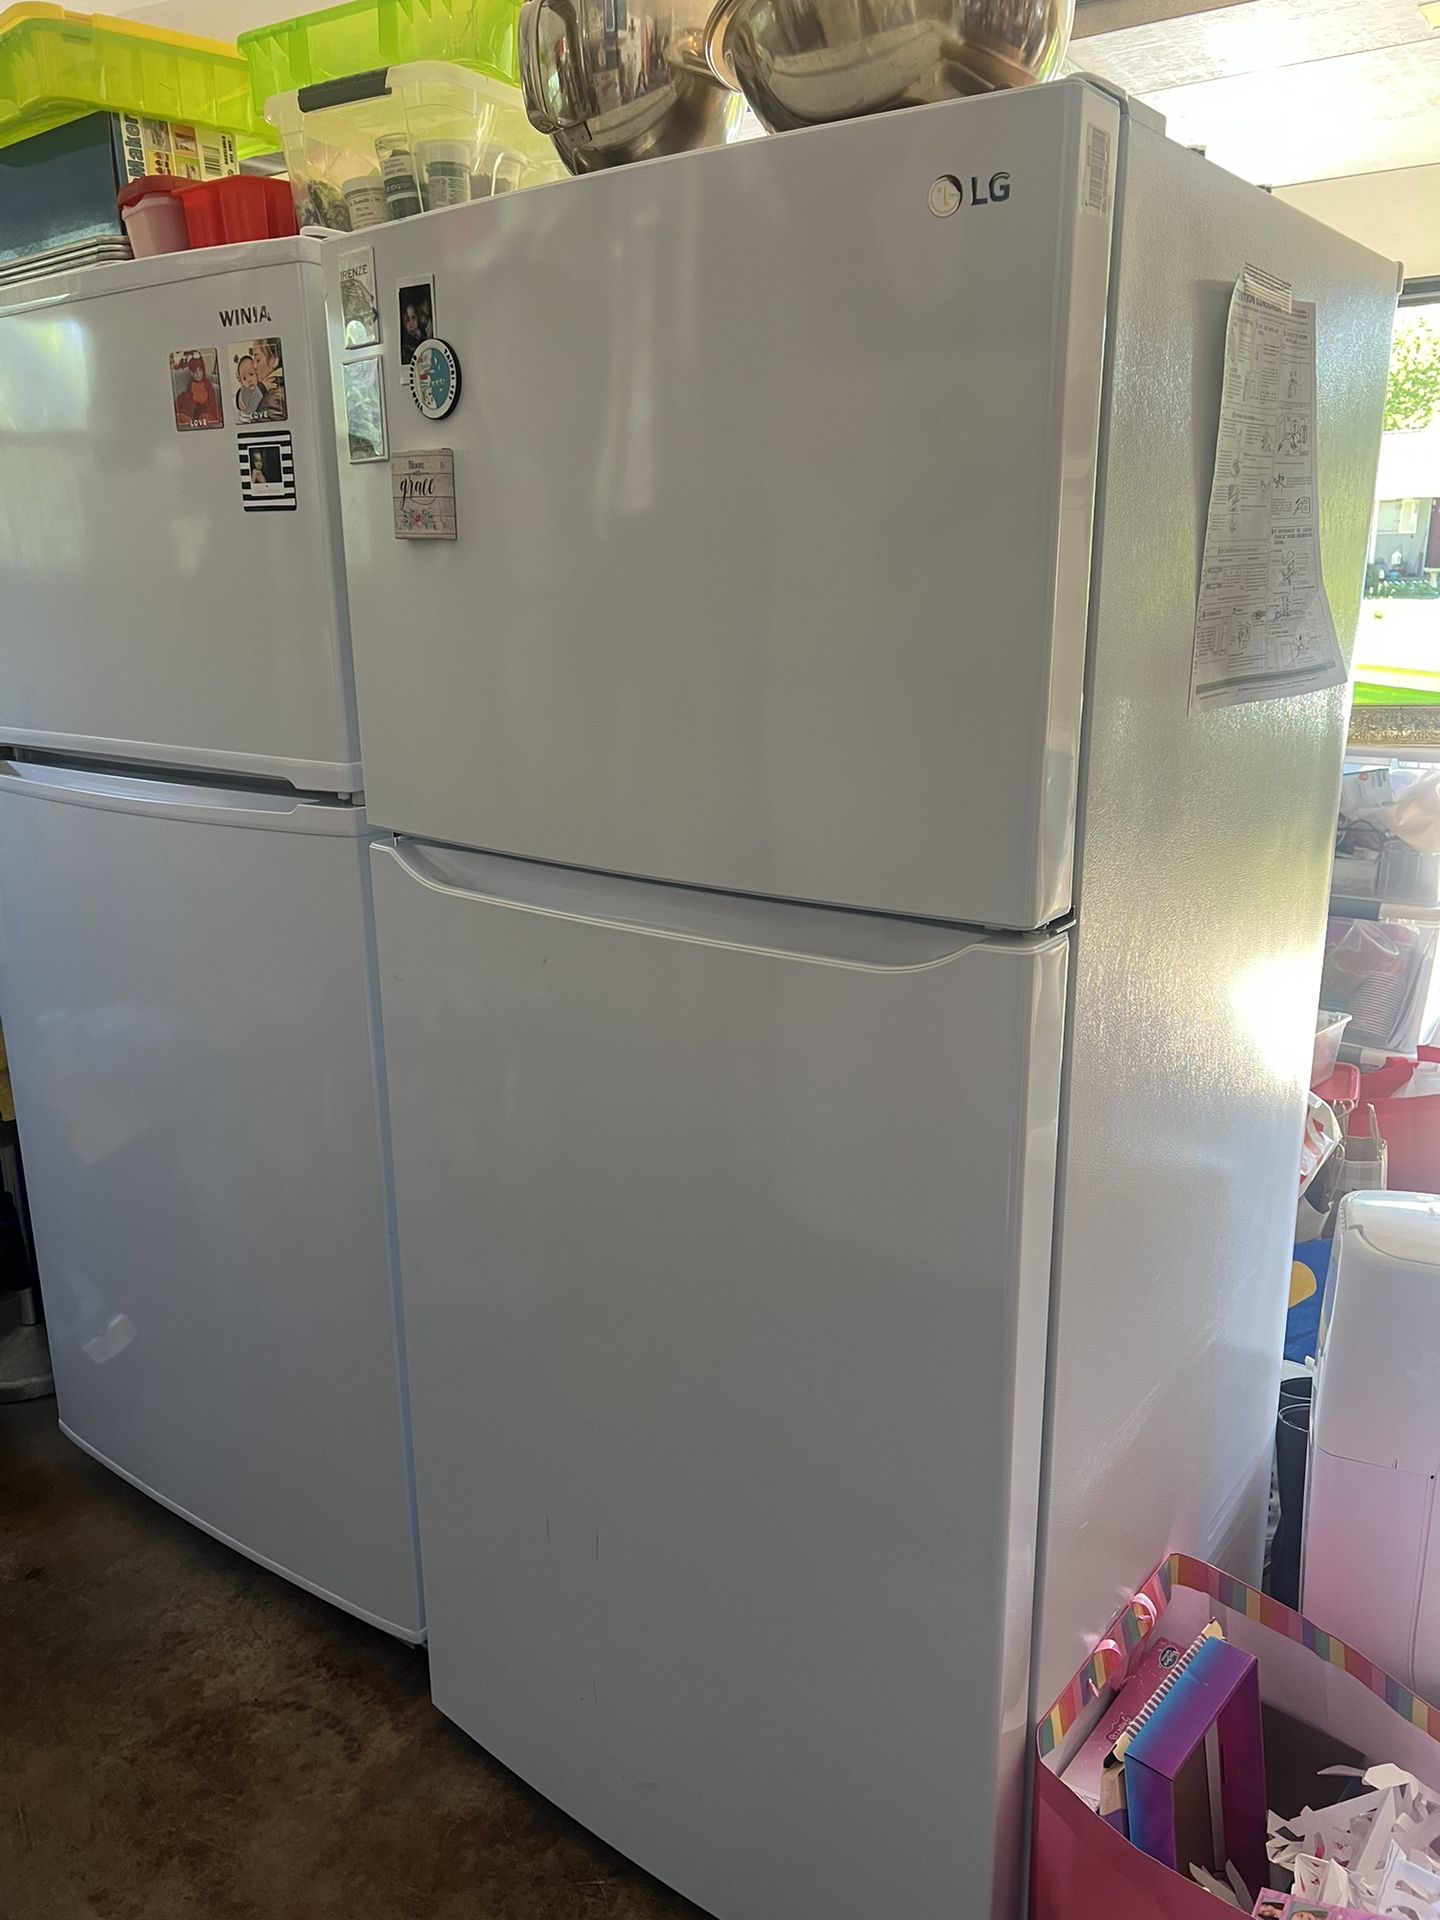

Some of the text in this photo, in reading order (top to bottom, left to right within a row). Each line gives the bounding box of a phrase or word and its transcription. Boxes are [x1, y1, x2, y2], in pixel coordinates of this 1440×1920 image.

[970, 172, 1011, 206] LG
[250, 410, 269, 420] LOVE
[190, 418, 207, 427] LOVE
